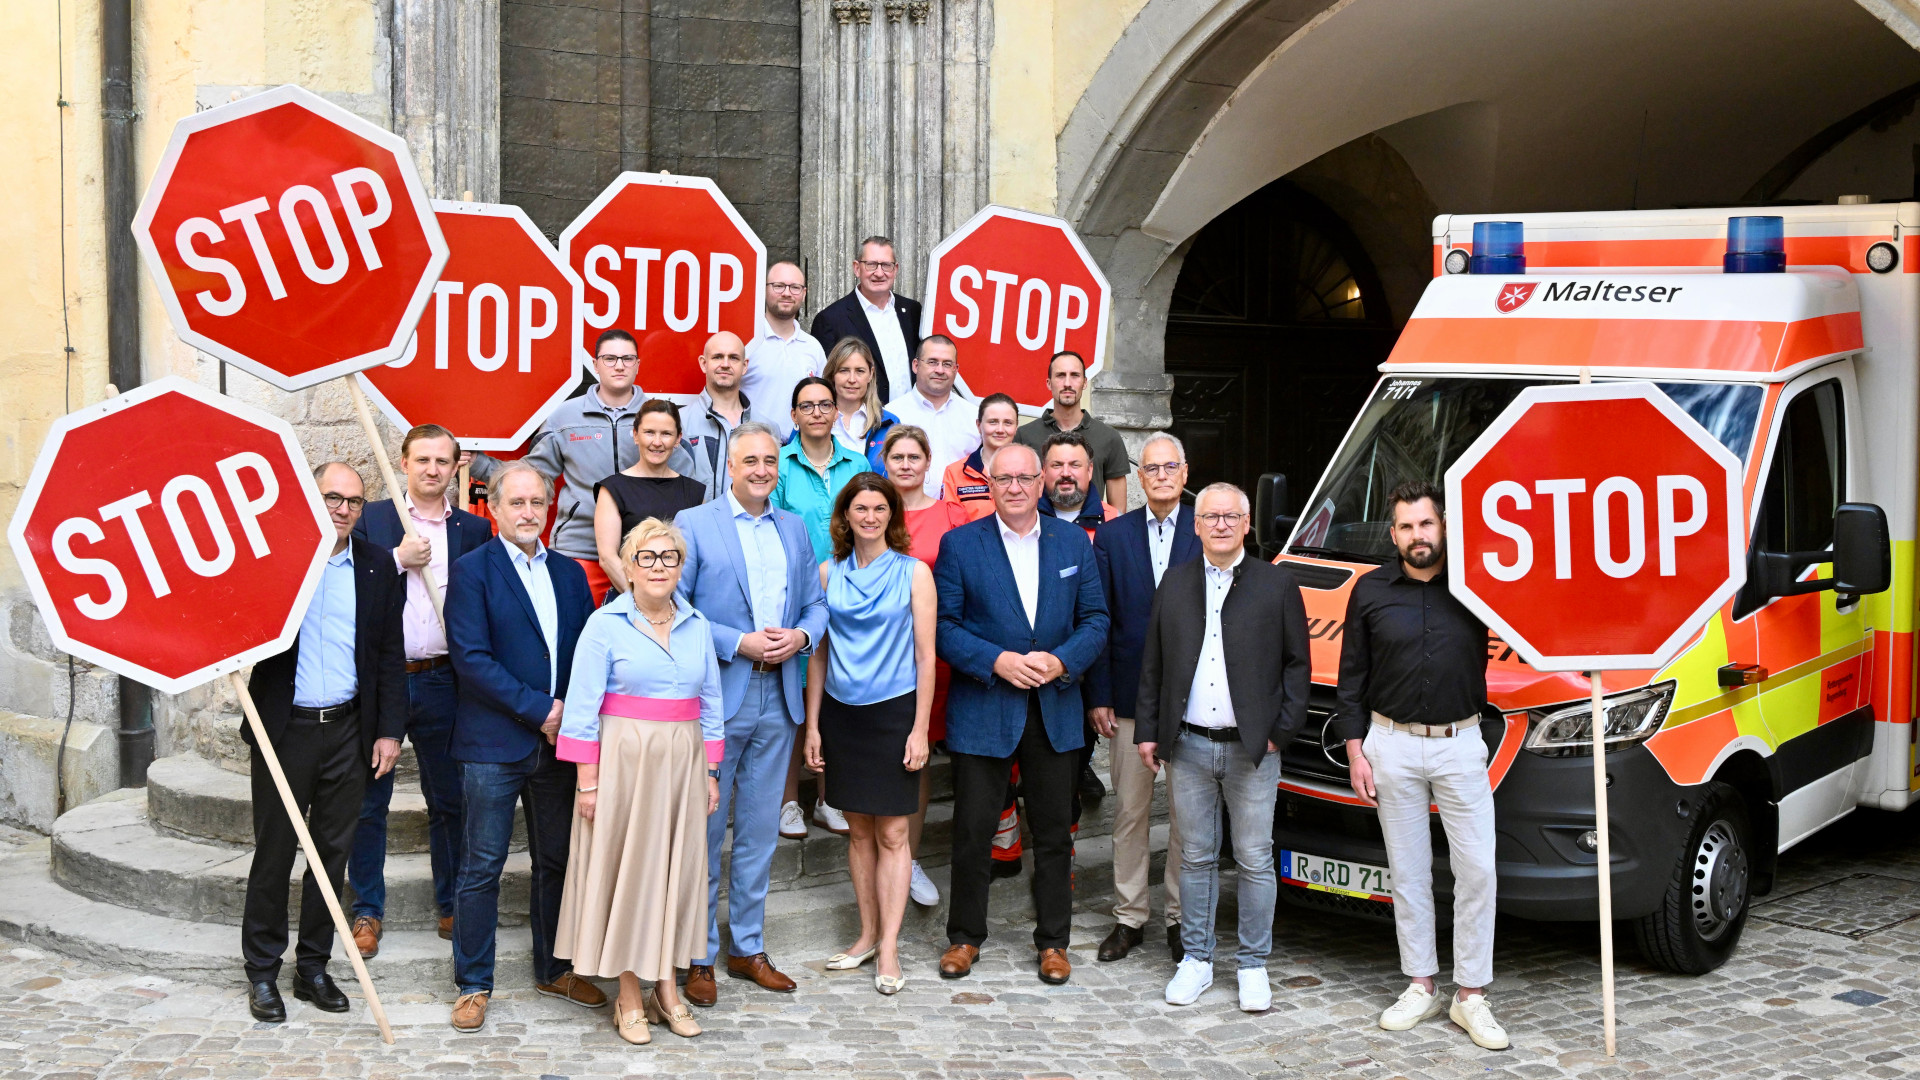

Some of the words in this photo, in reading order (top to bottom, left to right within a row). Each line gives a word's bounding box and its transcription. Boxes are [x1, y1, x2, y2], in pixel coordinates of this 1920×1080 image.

[176, 167, 392, 316] STOP
[583, 244, 743, 333] STOP
[946, 265, 1089, 354] STOP
[1542, 280, 1683, 303] Malteser
[1382, 386, 1418, 400] 71/1
[52, 452, 279, 620] STOP
[1482, 475, 1707, 581] STOP
[1284, 865, 1289, 873] D
[1297, 856, 1309, 879] R
[1323, 860, 1350, 887] RD
[1358, 867, 1392, 894] 71
